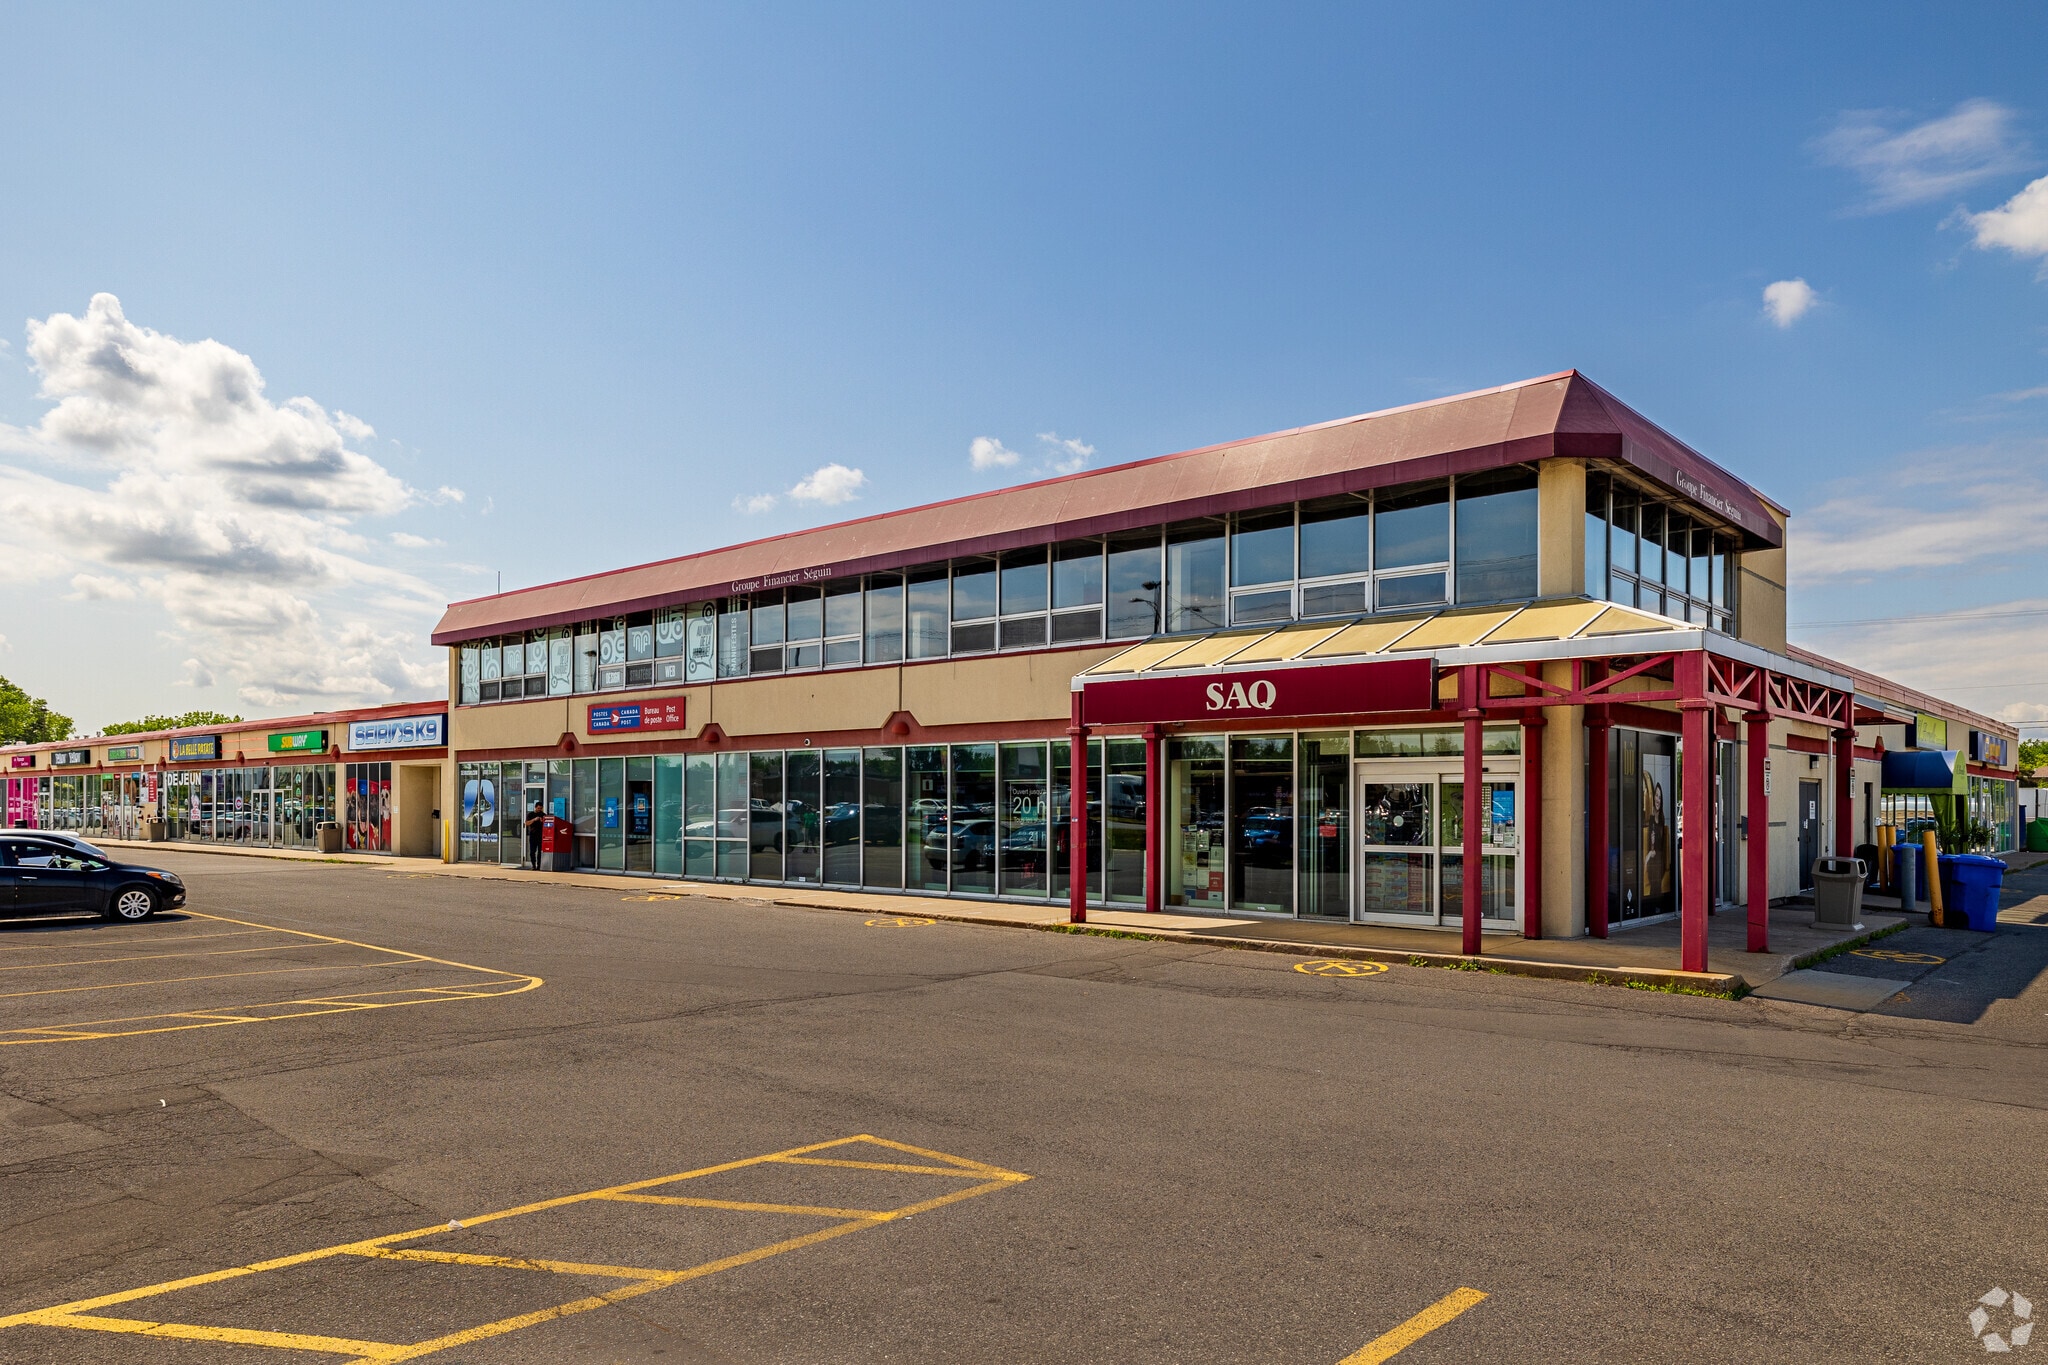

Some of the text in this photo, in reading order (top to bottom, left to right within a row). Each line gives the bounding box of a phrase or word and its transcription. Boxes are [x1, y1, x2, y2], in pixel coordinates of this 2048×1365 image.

[1676, 469, 1698, 496] Groupe
[1699, 483, 1724, 511] Financier
[731, 565, 832, 593] Groupe Financier Séguin
[664, 665, 676, 677] WEB
[1206, 680, 1277, 711] SAQ
[665, 705, 676, 713] Post
[644, 716, 662, 725] de poste
[665, 714, 679, 722] Office
[415, 719, 437, 742] K9
[179, 742, 214, 756] LA BELLE PATATE
[281, 734, 308, 749] SUBWAY
[1013, 796, 1046, 814] 20 h
